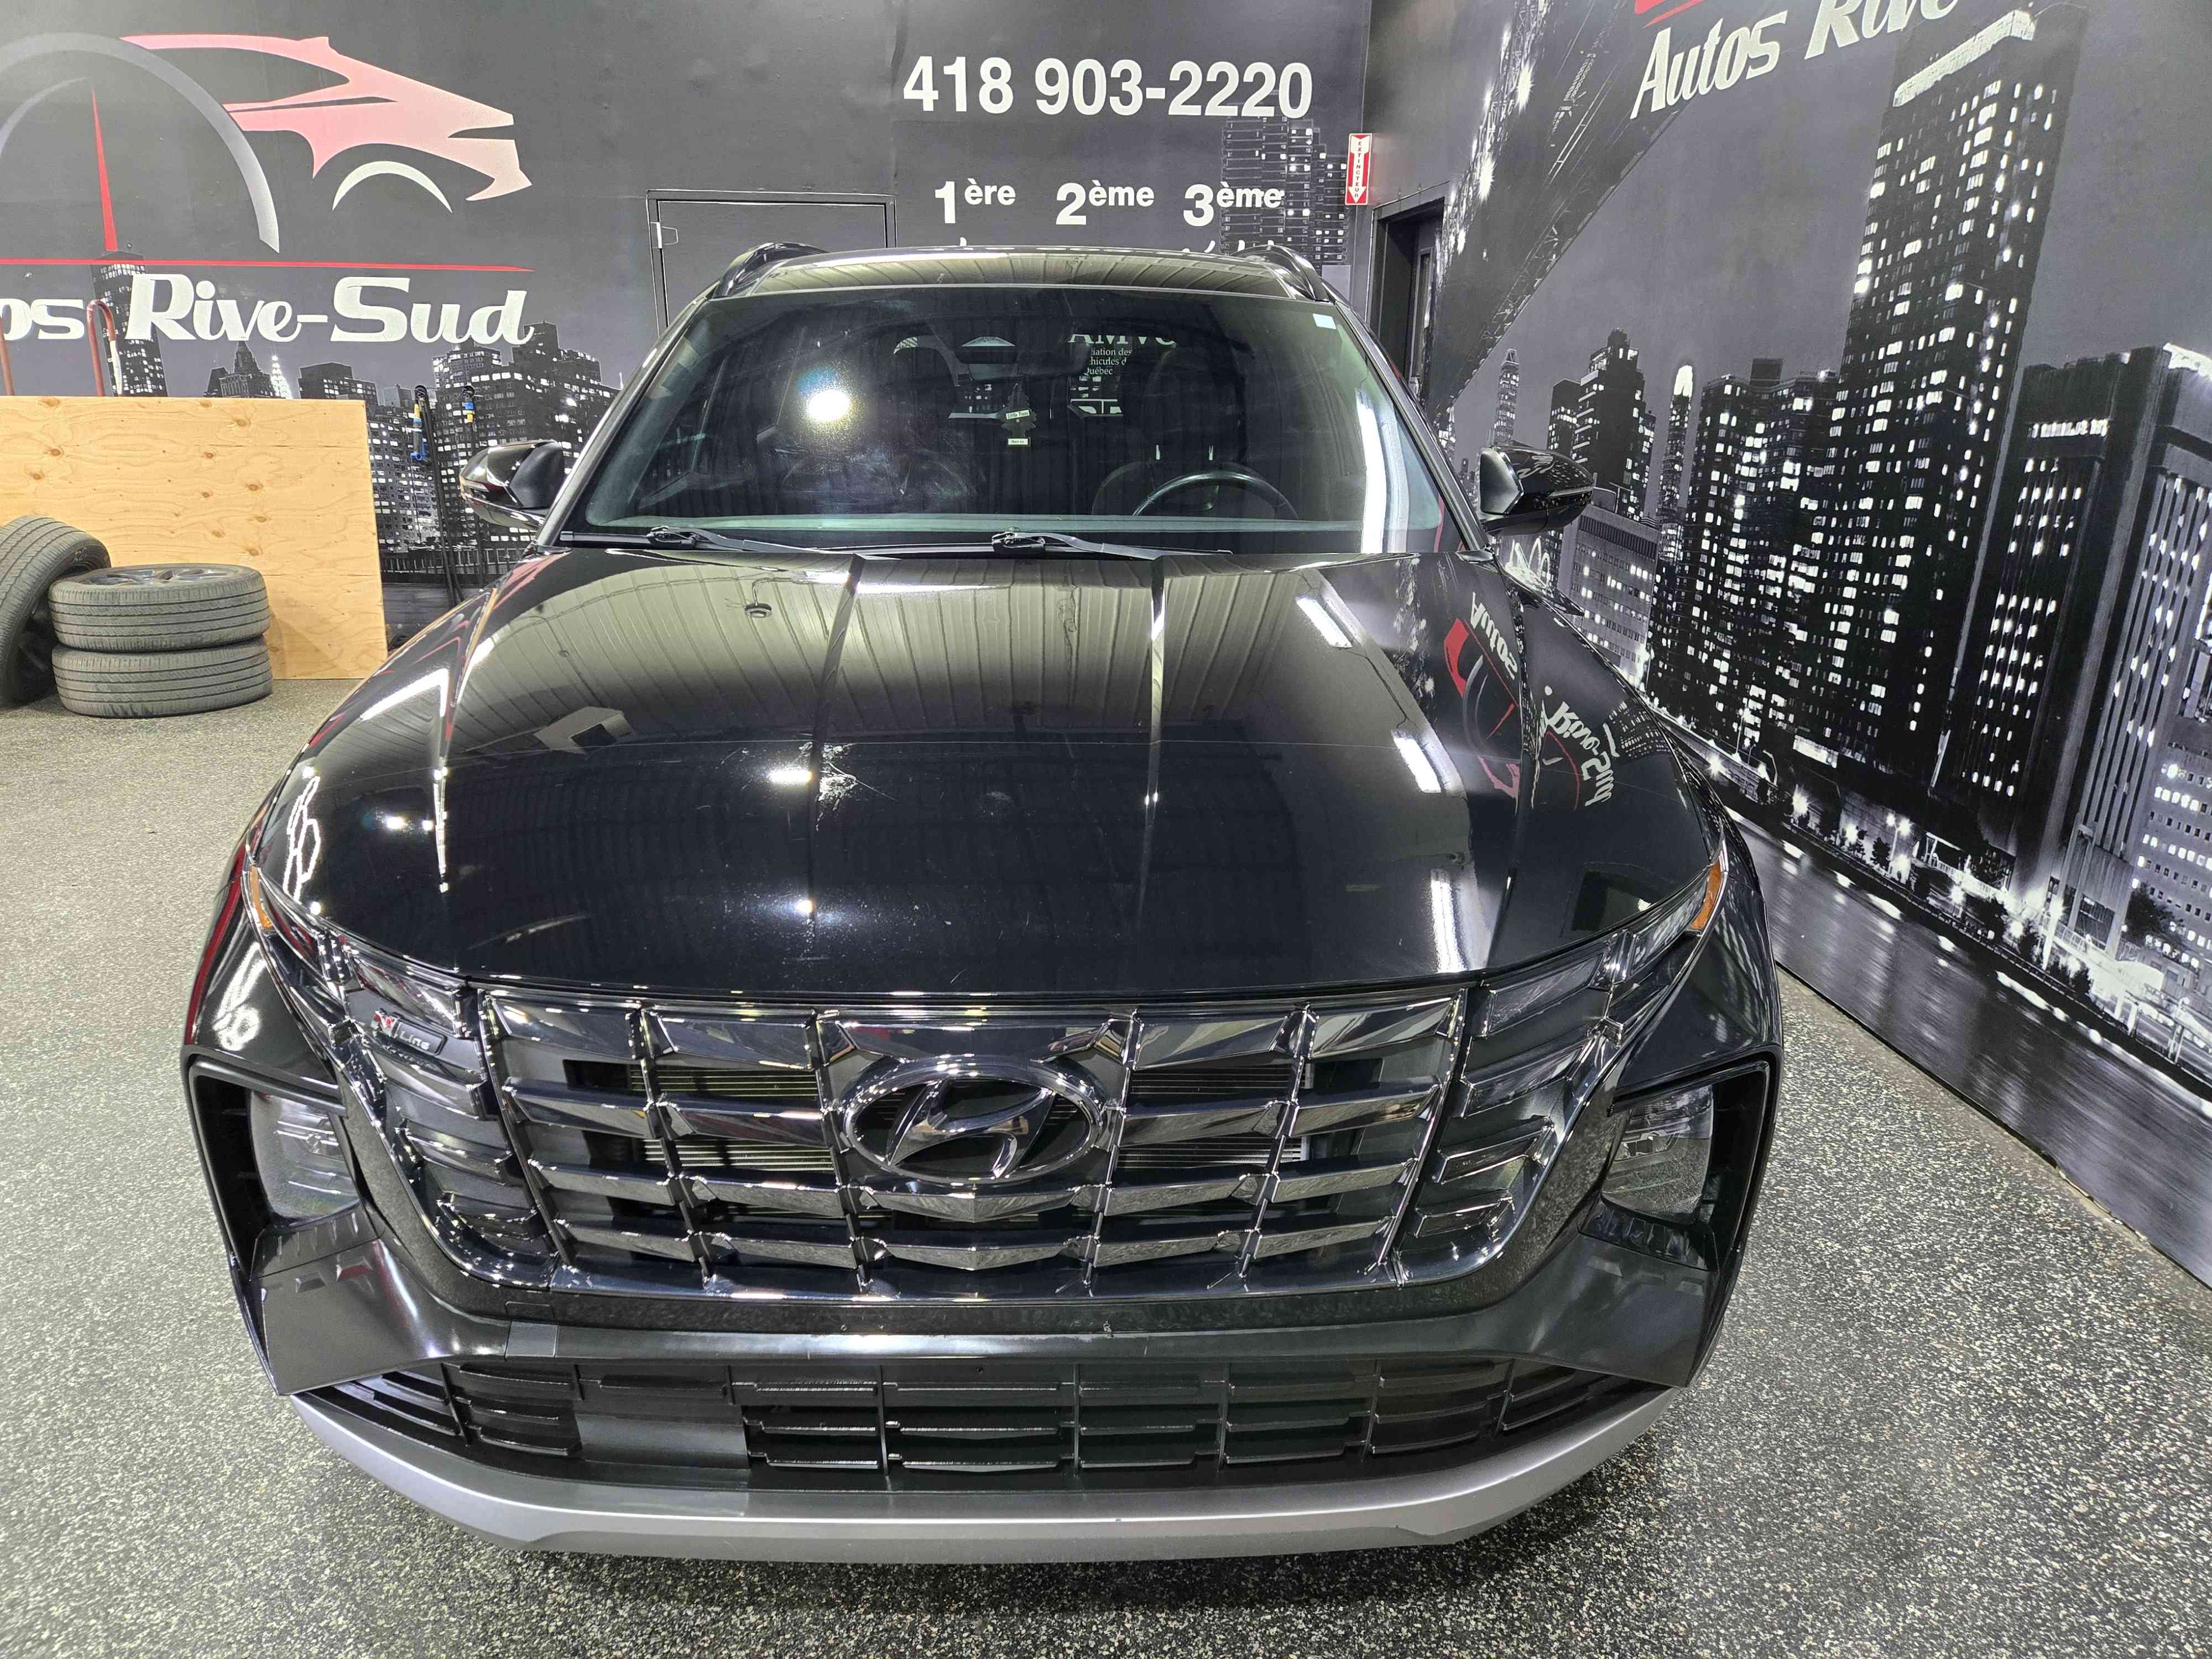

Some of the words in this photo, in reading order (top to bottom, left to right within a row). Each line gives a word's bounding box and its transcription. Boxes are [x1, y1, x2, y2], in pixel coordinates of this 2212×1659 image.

[903, 55, 1014, 114] 418
[1035, 58, 1313, 119] 903-2220
[1630, 9, 1788, 119] Autos
[935, 178, 1016, 224] 1ère
[1056, 180, 1155, 226] 2ème
[1183, 181, 1285, 227] 3ème
[124, 273, 535, 345] Rive-Sud
[1089, 357, 1120, 366] hicules
[399, 1030, 430, 1050] Line
